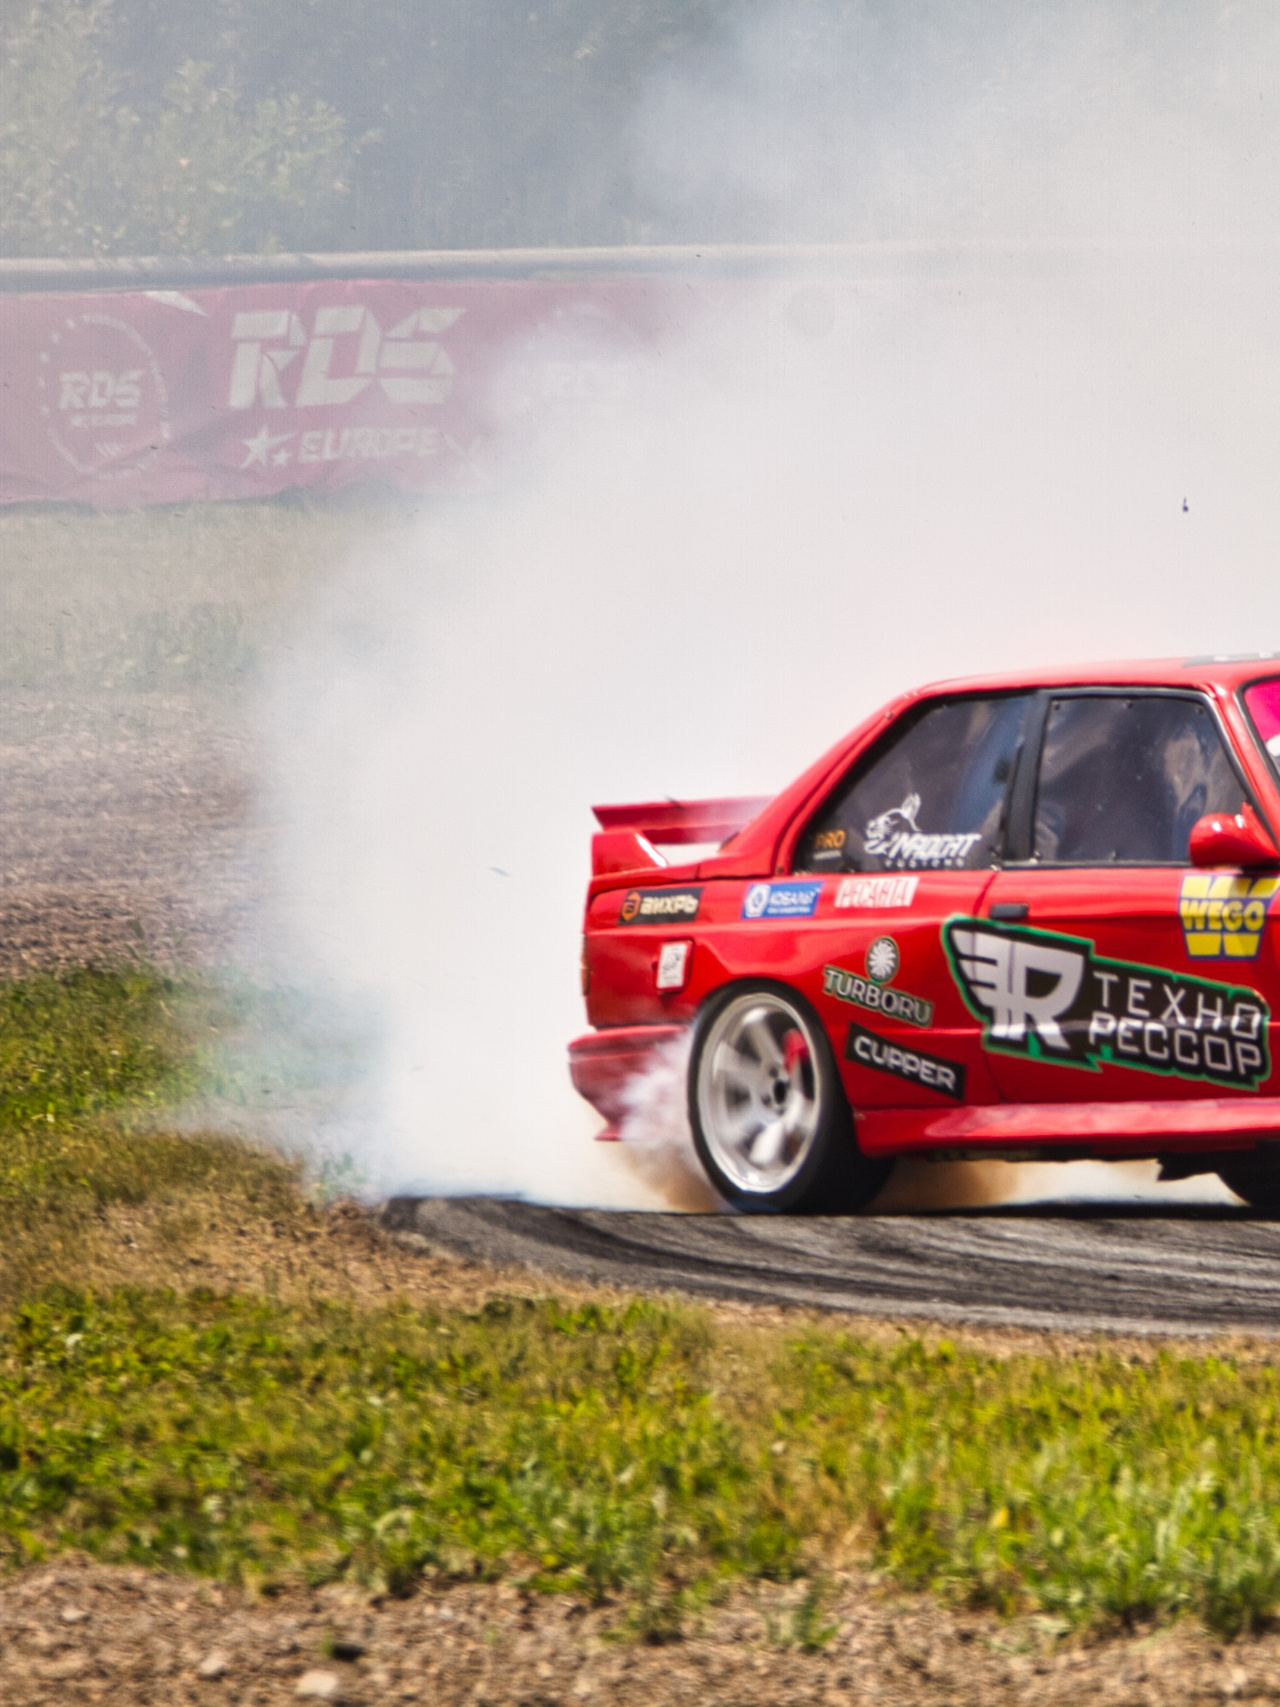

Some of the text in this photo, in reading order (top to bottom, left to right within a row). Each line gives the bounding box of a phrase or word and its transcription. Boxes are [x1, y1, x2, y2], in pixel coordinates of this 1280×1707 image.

[230, 304, 467, 410] RDS
[58, 370, 144, 409] RDS
[298, 428, 439, 463] EUROPE
[1179, 899, 1265, 931] WEGO
[825, 969, 932, 1024] TURBORU
[1093, 971, 1262, 1039] ТЕХНО
[853, 1034, 957, 1091] CUPPER
[1088, 1011, 1262, 1075] РЕССОР
